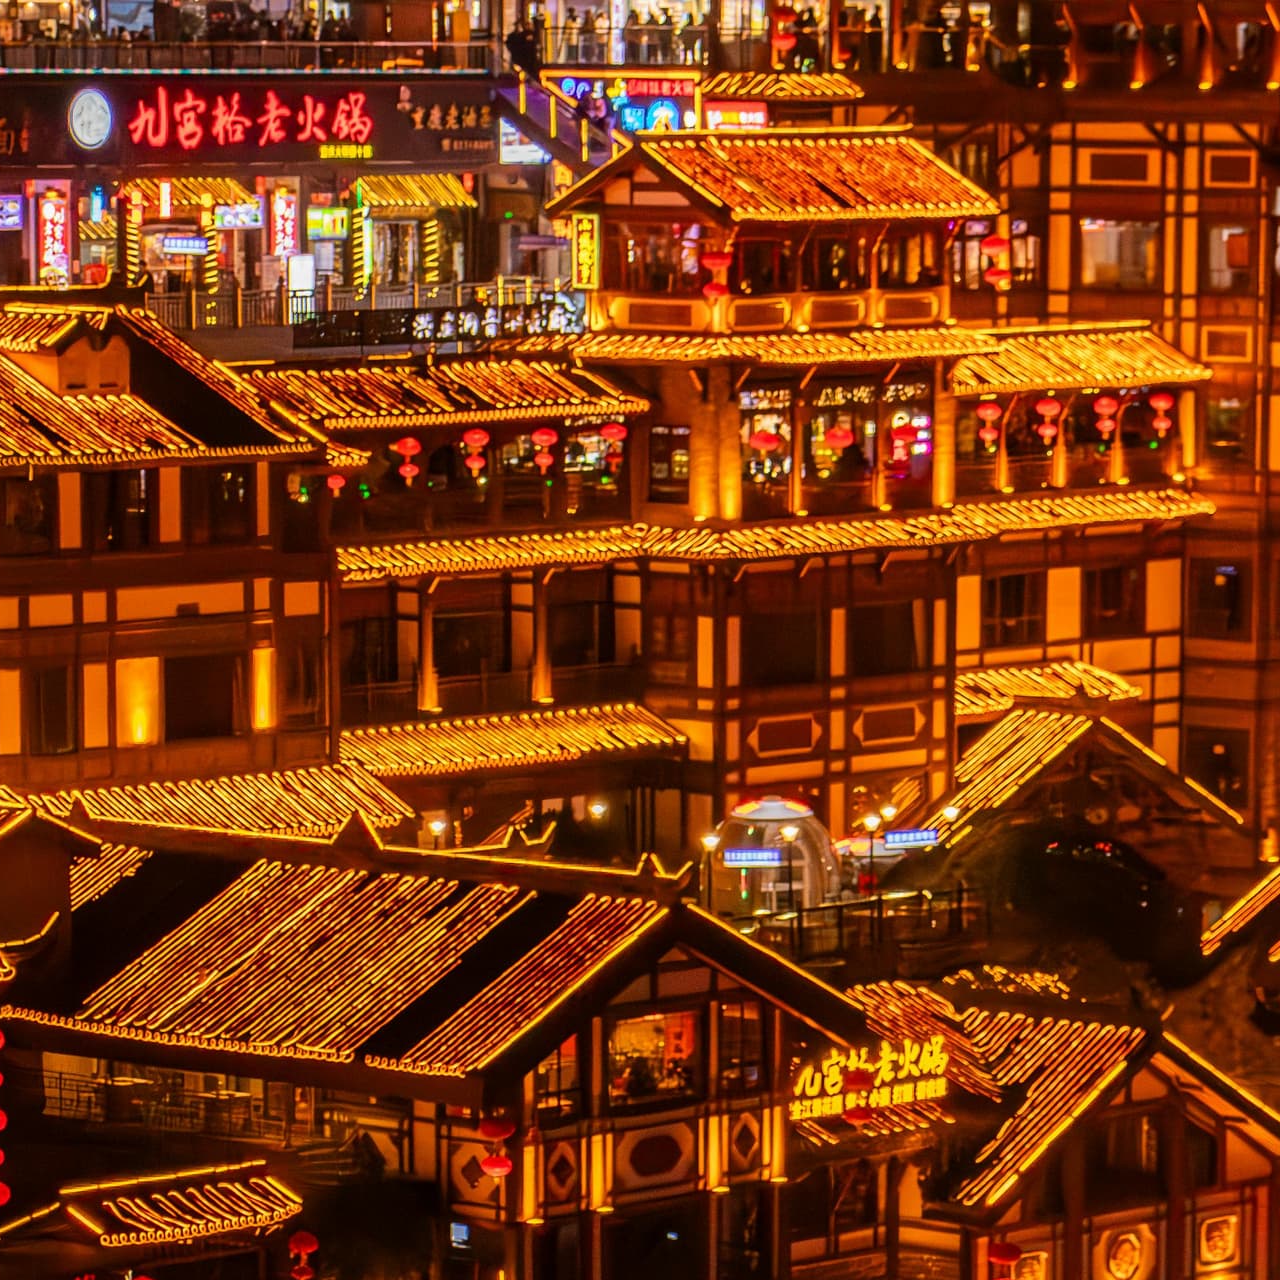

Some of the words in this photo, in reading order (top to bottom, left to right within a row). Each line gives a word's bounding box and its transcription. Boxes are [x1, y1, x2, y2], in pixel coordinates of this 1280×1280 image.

[128, 86, 373, 147] 九宫格老火锅
